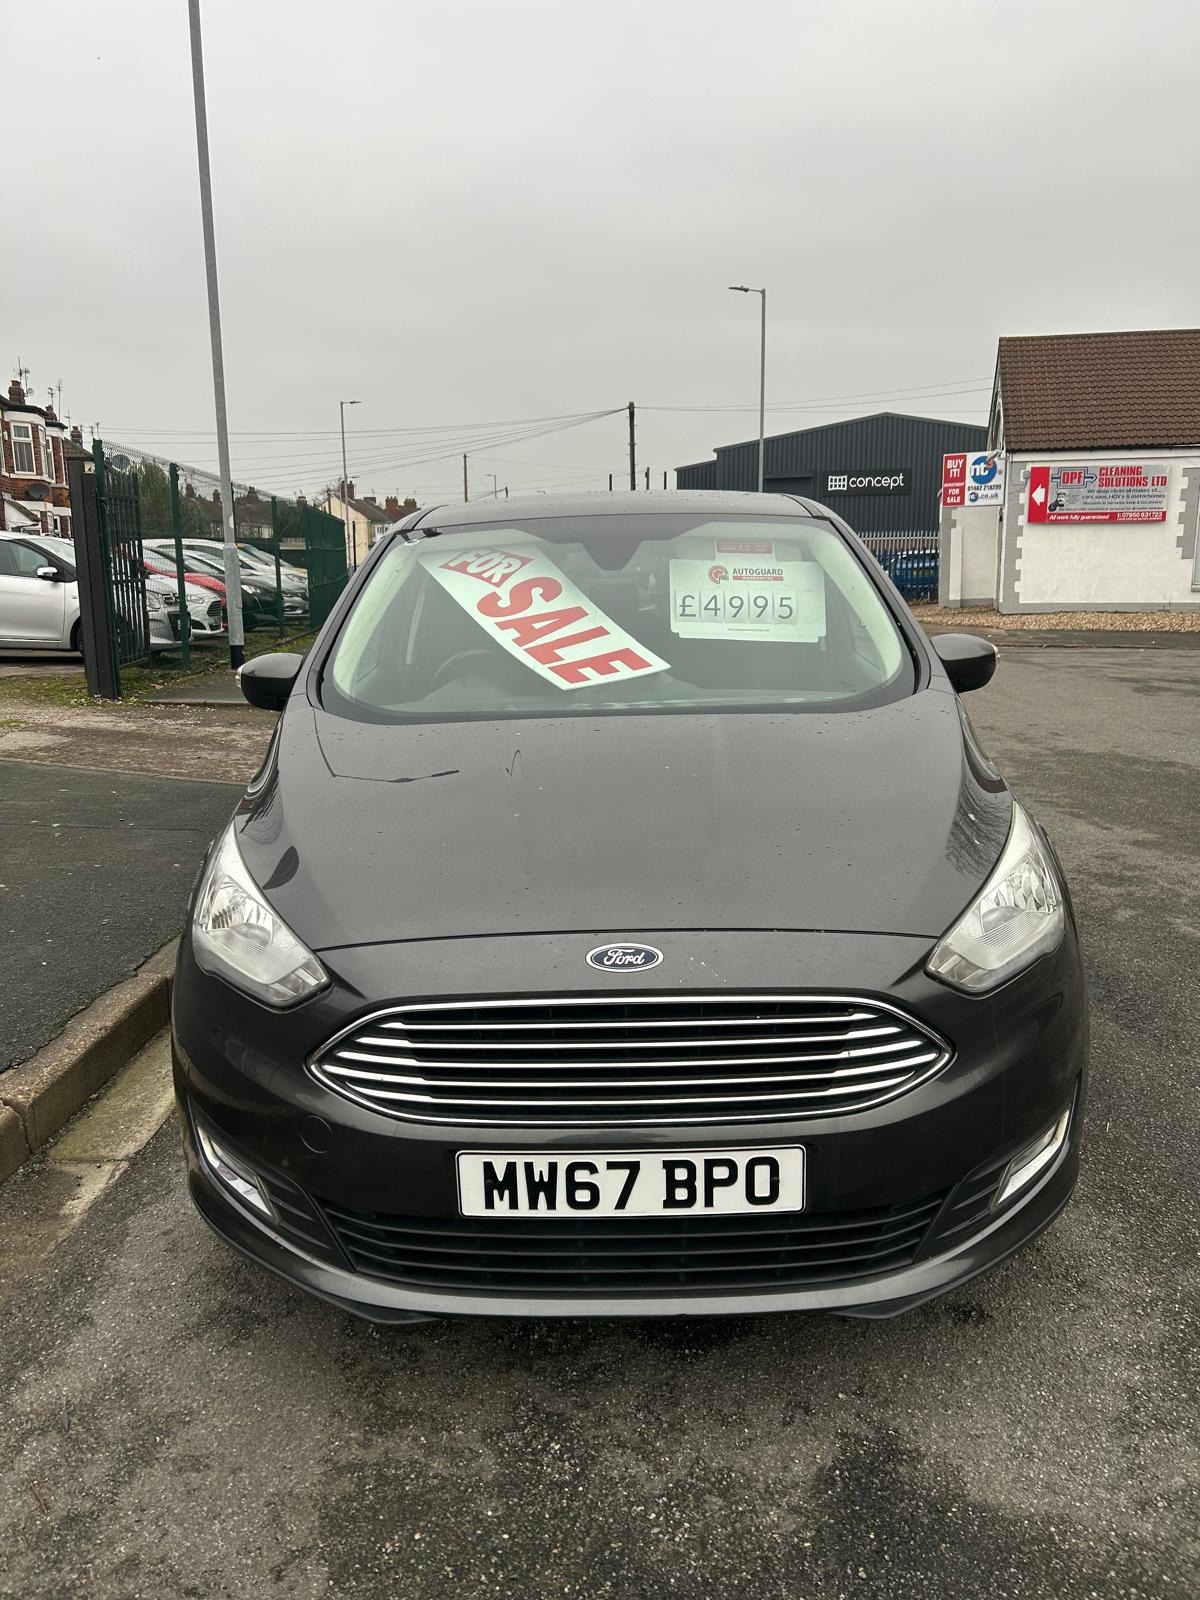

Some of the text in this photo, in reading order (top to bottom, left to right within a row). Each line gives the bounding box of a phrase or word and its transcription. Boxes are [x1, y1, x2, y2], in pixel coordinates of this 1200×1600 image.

[947, 459, 964, 469] BUY
[949, 469, 960, 478] IT!
[1099, 466, 1142, 477] CLEANING
[849, 473, 904, 490] concept
[1061, 471, 1083, 485] DPF
[1098, 476, 1168, 488] SOLUTIONS LTD
[948, 488, 960, 496] FOR
[946, 496, 961, 504] SALE
[1080, 513, 1110, 521] guaranteed
[732, 567, 784, 576] AUTOGUARD
[679, 594, 793, 620] £4995
[449, 549, 653, 685] FOR SALE
[603, 948, 646, 966] Ford
[482, 1156, 780, 1210] MW67 BPO
